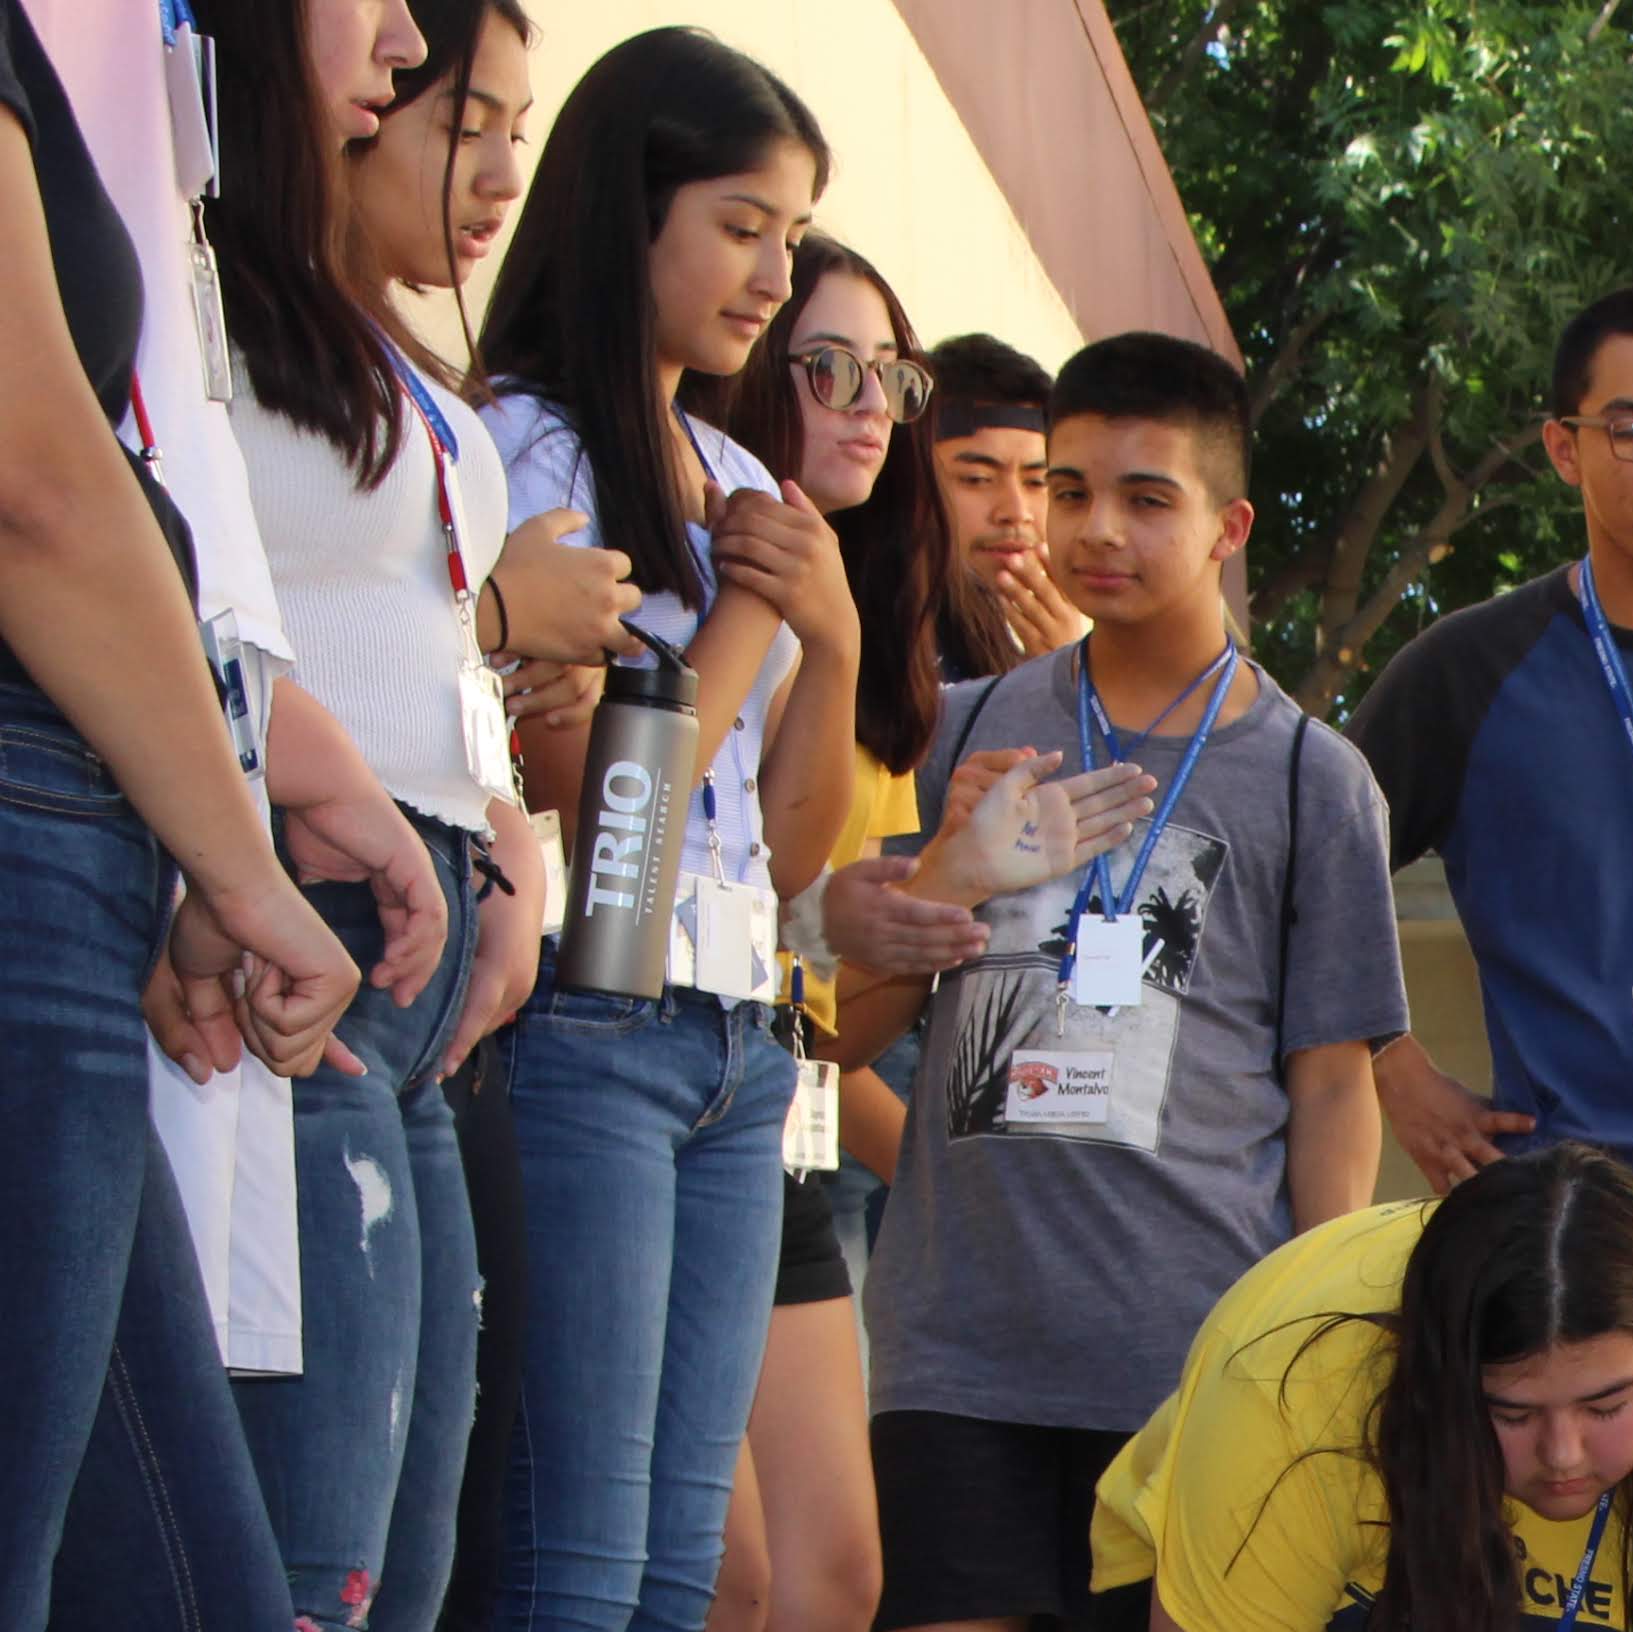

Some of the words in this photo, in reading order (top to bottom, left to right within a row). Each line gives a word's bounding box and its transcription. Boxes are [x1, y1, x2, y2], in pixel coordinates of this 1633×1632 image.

[585, 761, 652, 917] TRIO
[644, 856, 661, 913] TALENT
[655, 783, 672, 845] SEARCH
[1578, 1549, 1595, 1583] FRESNO
